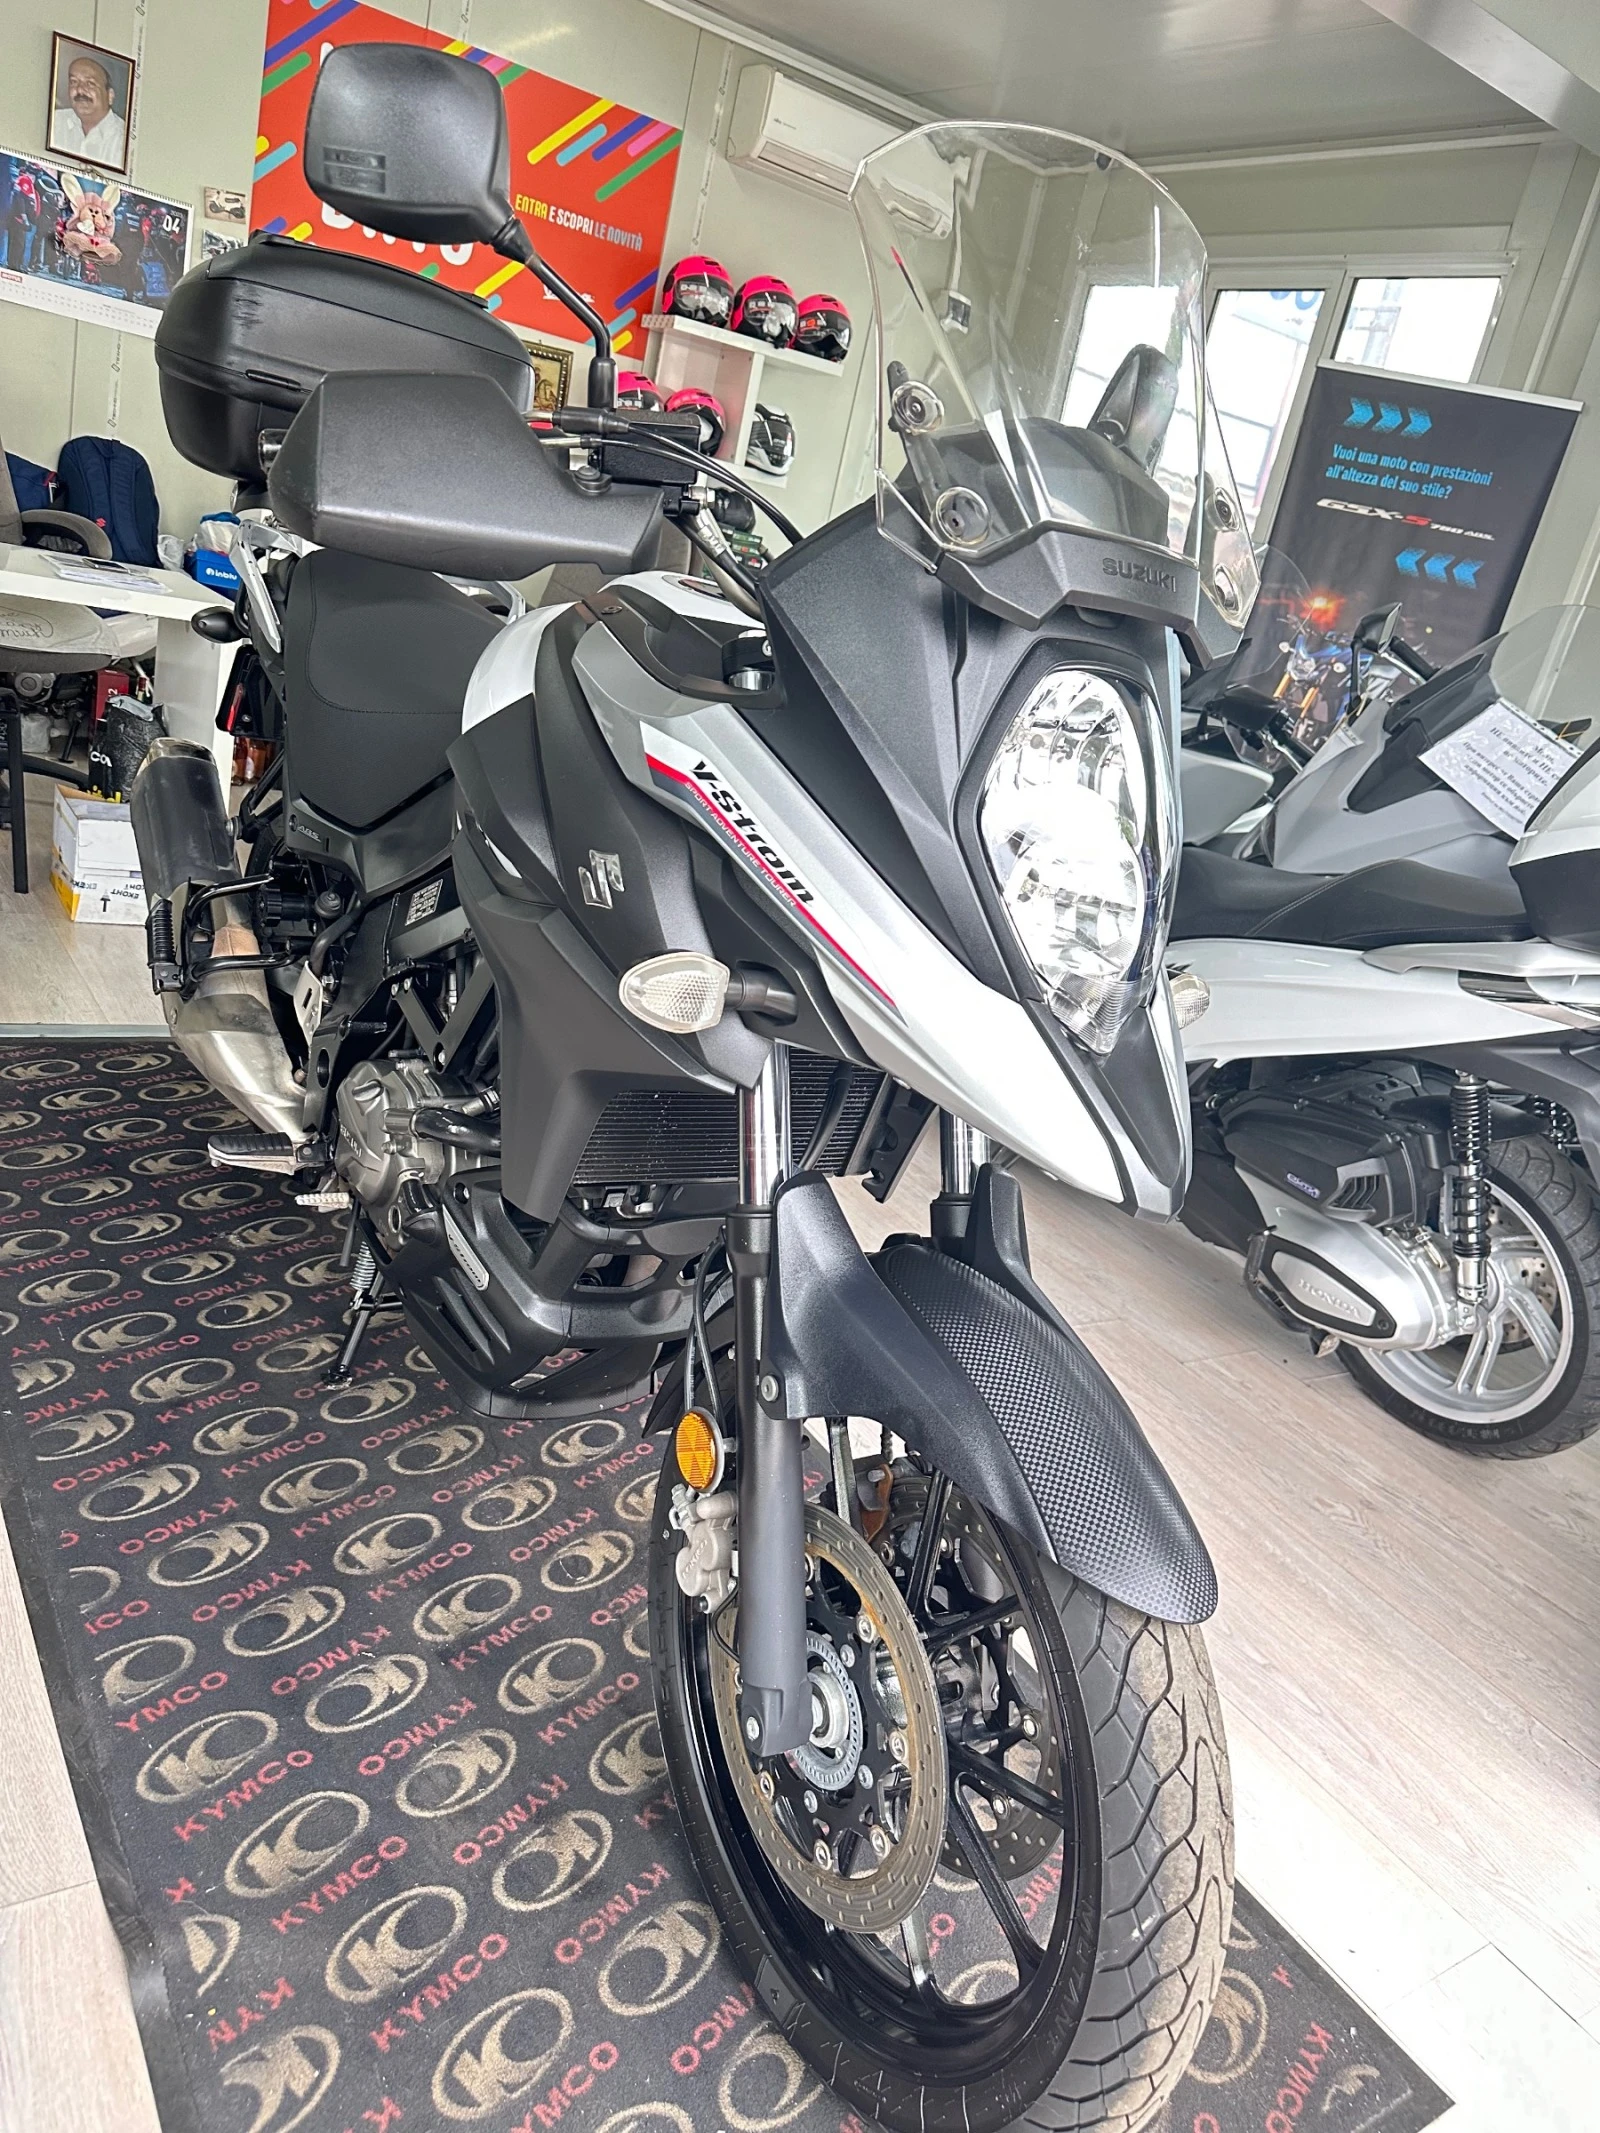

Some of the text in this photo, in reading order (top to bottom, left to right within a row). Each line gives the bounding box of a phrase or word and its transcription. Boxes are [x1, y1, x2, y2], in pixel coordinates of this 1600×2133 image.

[162, 214, 180, 234] 04
[515, 193, 643, 252] ENTRA E SCOPRI LE NOVITÀ
[1326, 465, 1453, 499] all'altezza del suo stile?
[1332, 444, 1493, 486] Vuoi una moto con prestazioni
[1102, 557, 1176, 593] SUZUKI
[297, 825, 321, 842] ABS
[684, 781, 797, 907] SPORT ADVENTURE TOURER
[690, 760, 816, 908] V-Strom
[16, 1074, 98, 1092] KYMCO
[121, 1069, 197, 1087] KYMCO
[59, 1103, 141, 1122] KYMCO
[103, 1133, 186, 1155] KYMCO
[22, 1163, 113, 1188] KYMCO
[69, 1198, 160, 1225] KYMCO
[200, 1199, 284, 1225] KYMCO
[120, 1235, 213, 1264] KYMCO
[253, 1234, 336, 1263] KYMCO
[41, 1290, 144, 1325] KYMCO
[174, 1274, 268, 1307] KYMCO
[1299, 1279, 1361, 1320] HONDA
[97, 1334, 200, 1373] KYMCO
[156, 1381, 261, 1424] KYMCO
[361, 1405, 455, 1450] KYMCO
[53, 1441, 172, 1491] KYMCO
[221, 1431, 327, 1479] KYMCO
[431, 1454, 525, 1503] KYMCO
[573, 1442, 655, 1489] KYMCO
[119, 1497, 238, 1555] KYMCO
[291, 1484, 397, 1538] KYMCO
[509, 1507, 600, 1562] KYMCO
[191, 1559, 312, 1623] KYMCO
[368, 1543, 473, 1601] KYMCO
[271, 1624, 392, 1696] KYMCO
[450, 1605, 553, 1670] KYMCO
[538, 1672, 640, 1744] KYMCO
[357, 1697, 477, 1776] KYMCO
[173, 1750, 314, 1842] KYMCO
[451, 1774, 568, 1866] KYMCO
[270, 1835, 408, 1934] KYMCO
[553, 1862, 671, 1964] KYMCO
[368, 1932, 509, 2053] KYMCO
